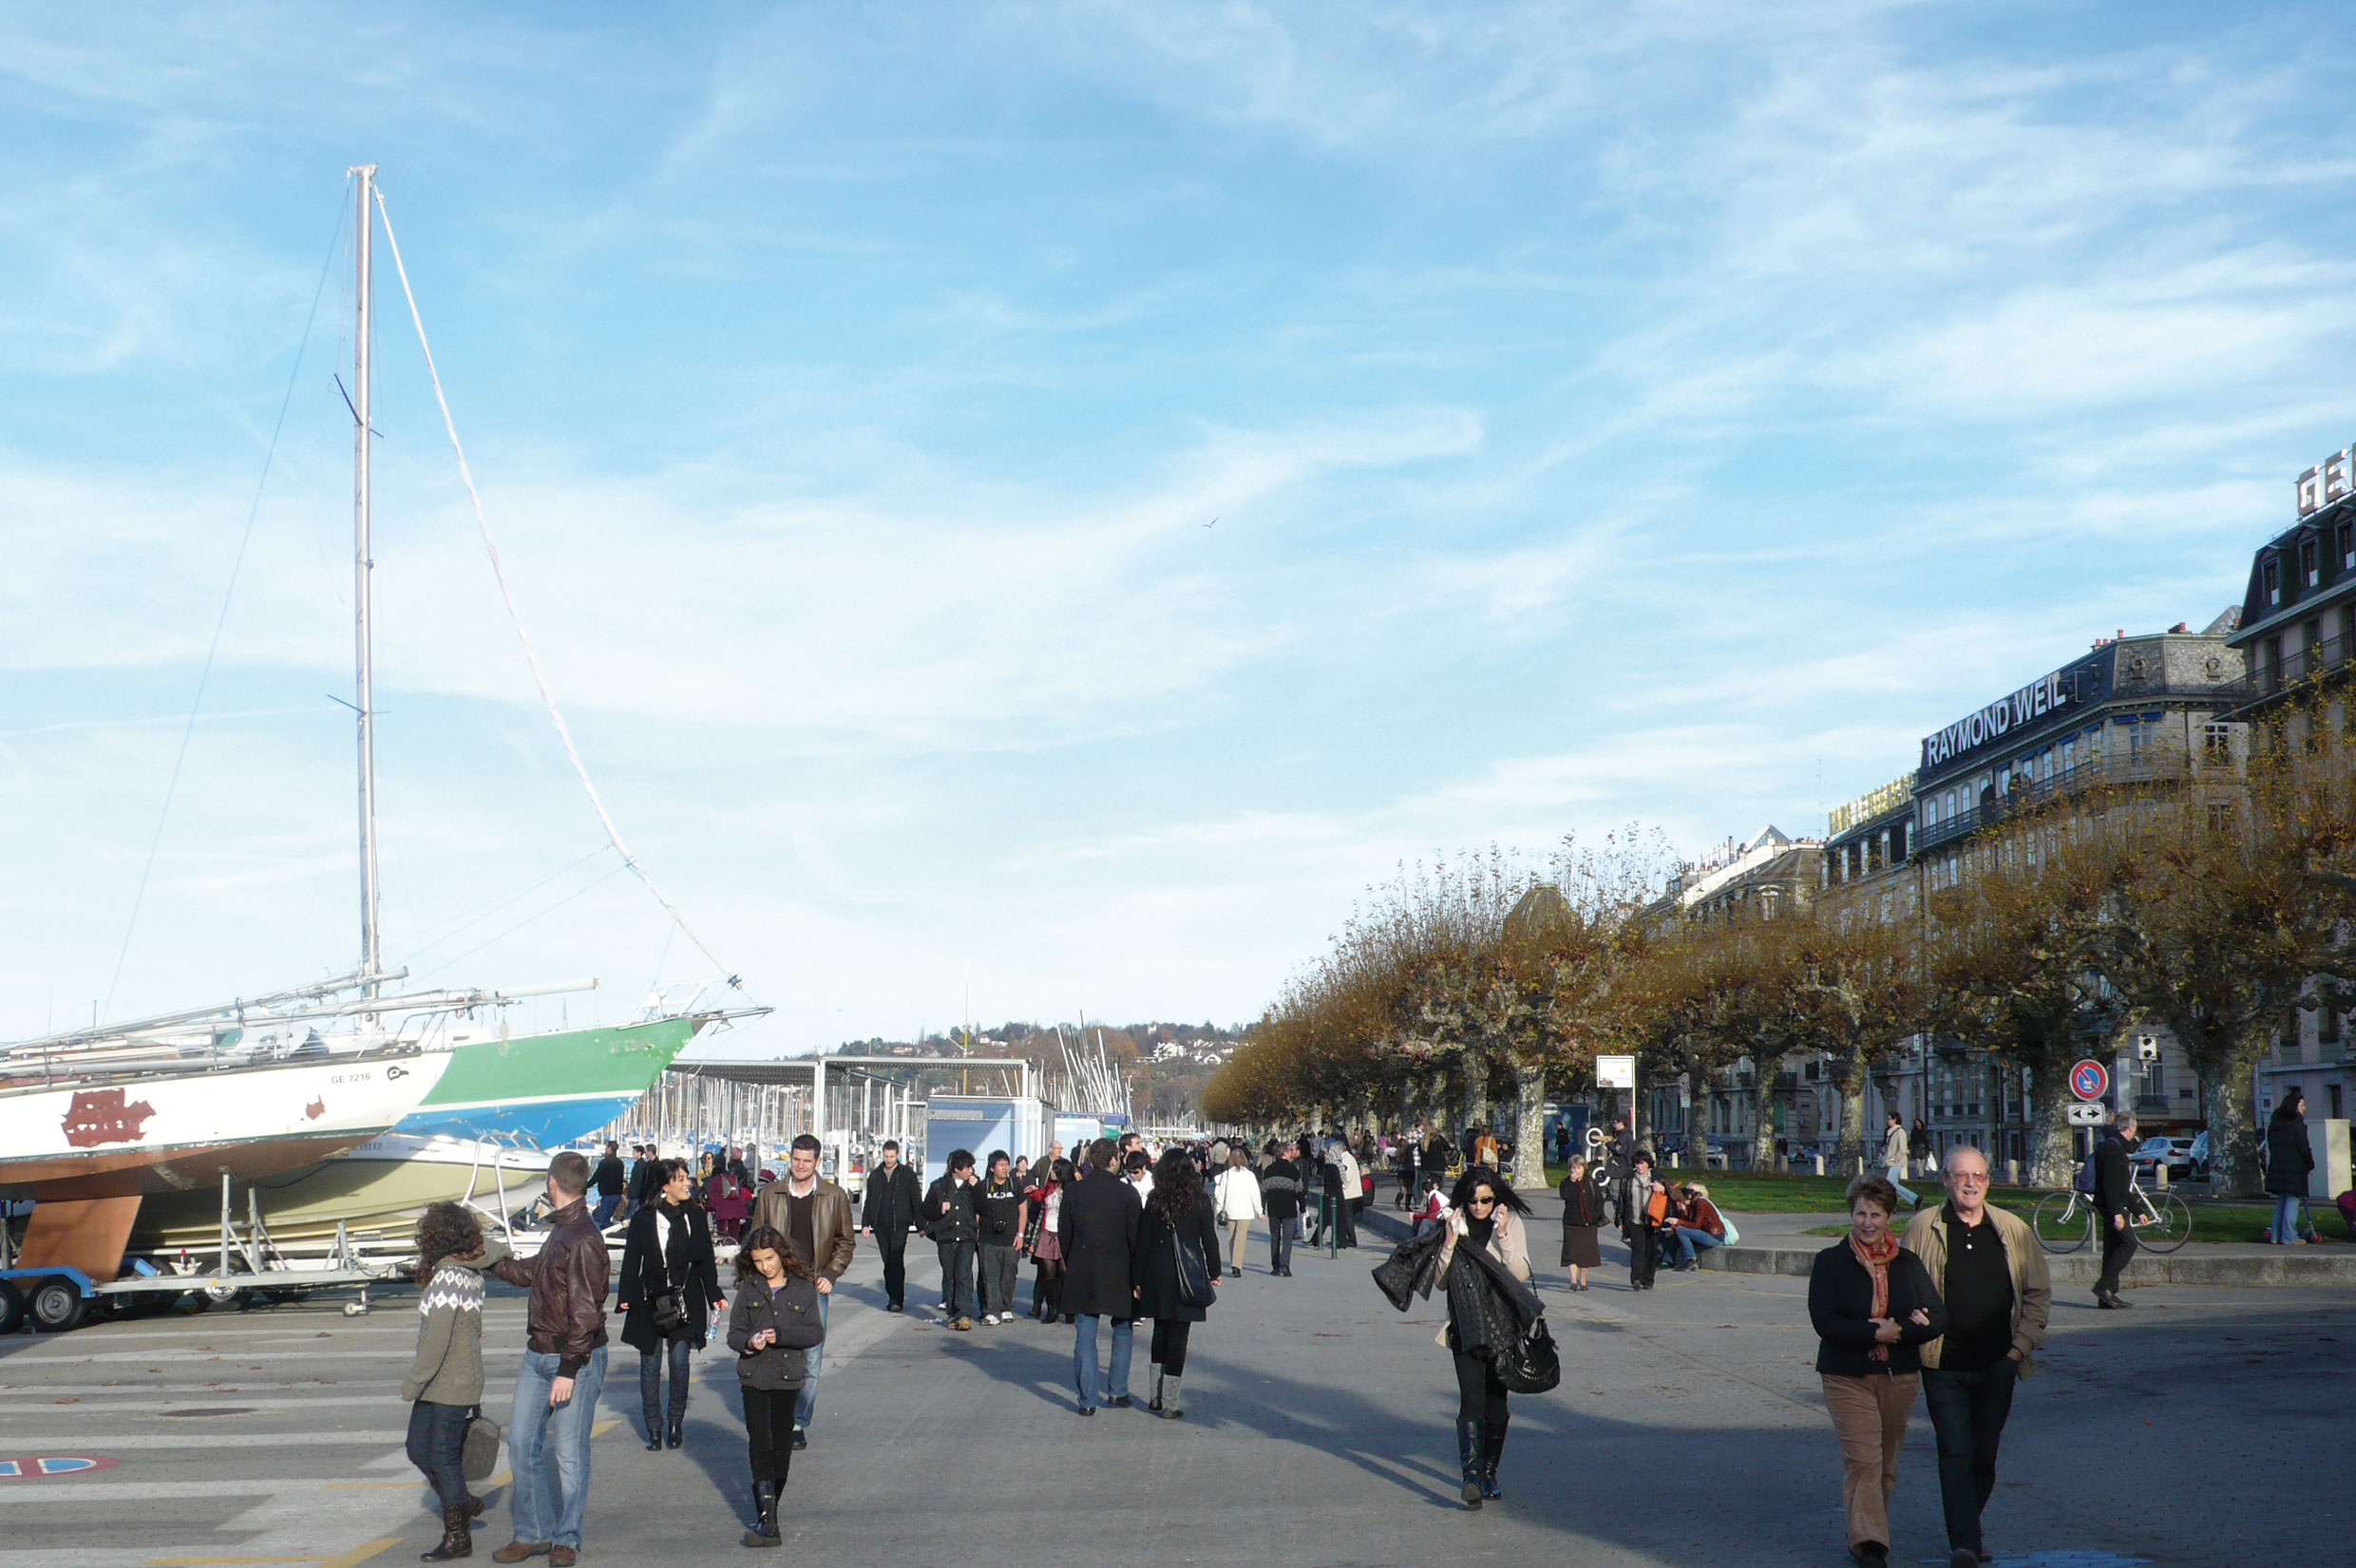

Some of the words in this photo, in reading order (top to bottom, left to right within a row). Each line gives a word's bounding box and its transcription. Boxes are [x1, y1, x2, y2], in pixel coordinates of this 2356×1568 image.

[2297, 443, 2356, 516] GE
[1928, 699, 2010, 766] RAYMOND
[2013, 671, 2066, 726] WEIL
[331, 1075, 346, 1084] GE
[349, 1072, 371, 1083] 7216
